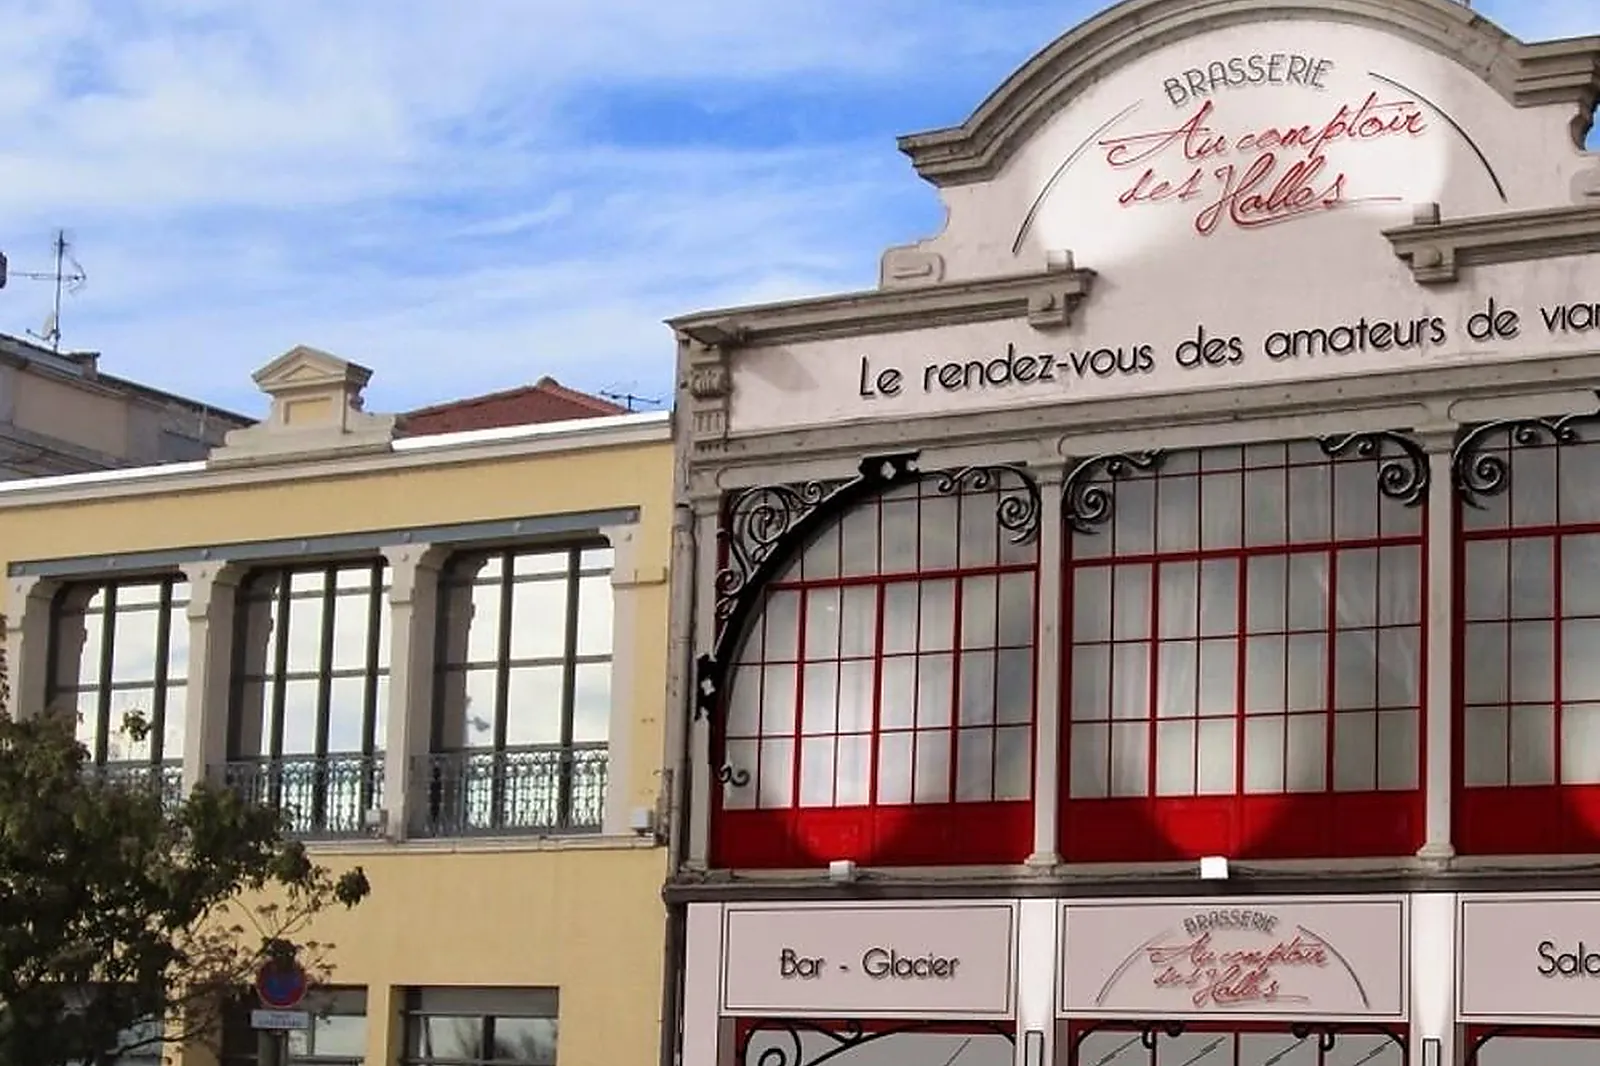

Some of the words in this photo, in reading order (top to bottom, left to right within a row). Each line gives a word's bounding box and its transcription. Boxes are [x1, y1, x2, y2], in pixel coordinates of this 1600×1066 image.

[1163, 54, 1334, 106] BRASSERIE
[1099, 100, 1226, 166] Au
[1235, 91, 1427, 158] comptoir
[1118, 168, 1206, 205] des
[1195, 152, 1352, 233] Halles
[859, 356, 902, 397] Le
[923, 342, 1154, 392] rendez-vous
[1175, 324, 1244, 367] des
[1264, 316, 1446, 358] amateurs
[1467, 297, 1520, 340] de
[1183, 910, 1278, 937] BRASSERIE
[780, 948, 825, 978] Bar
[862, 947, 961, 978] Glacier
